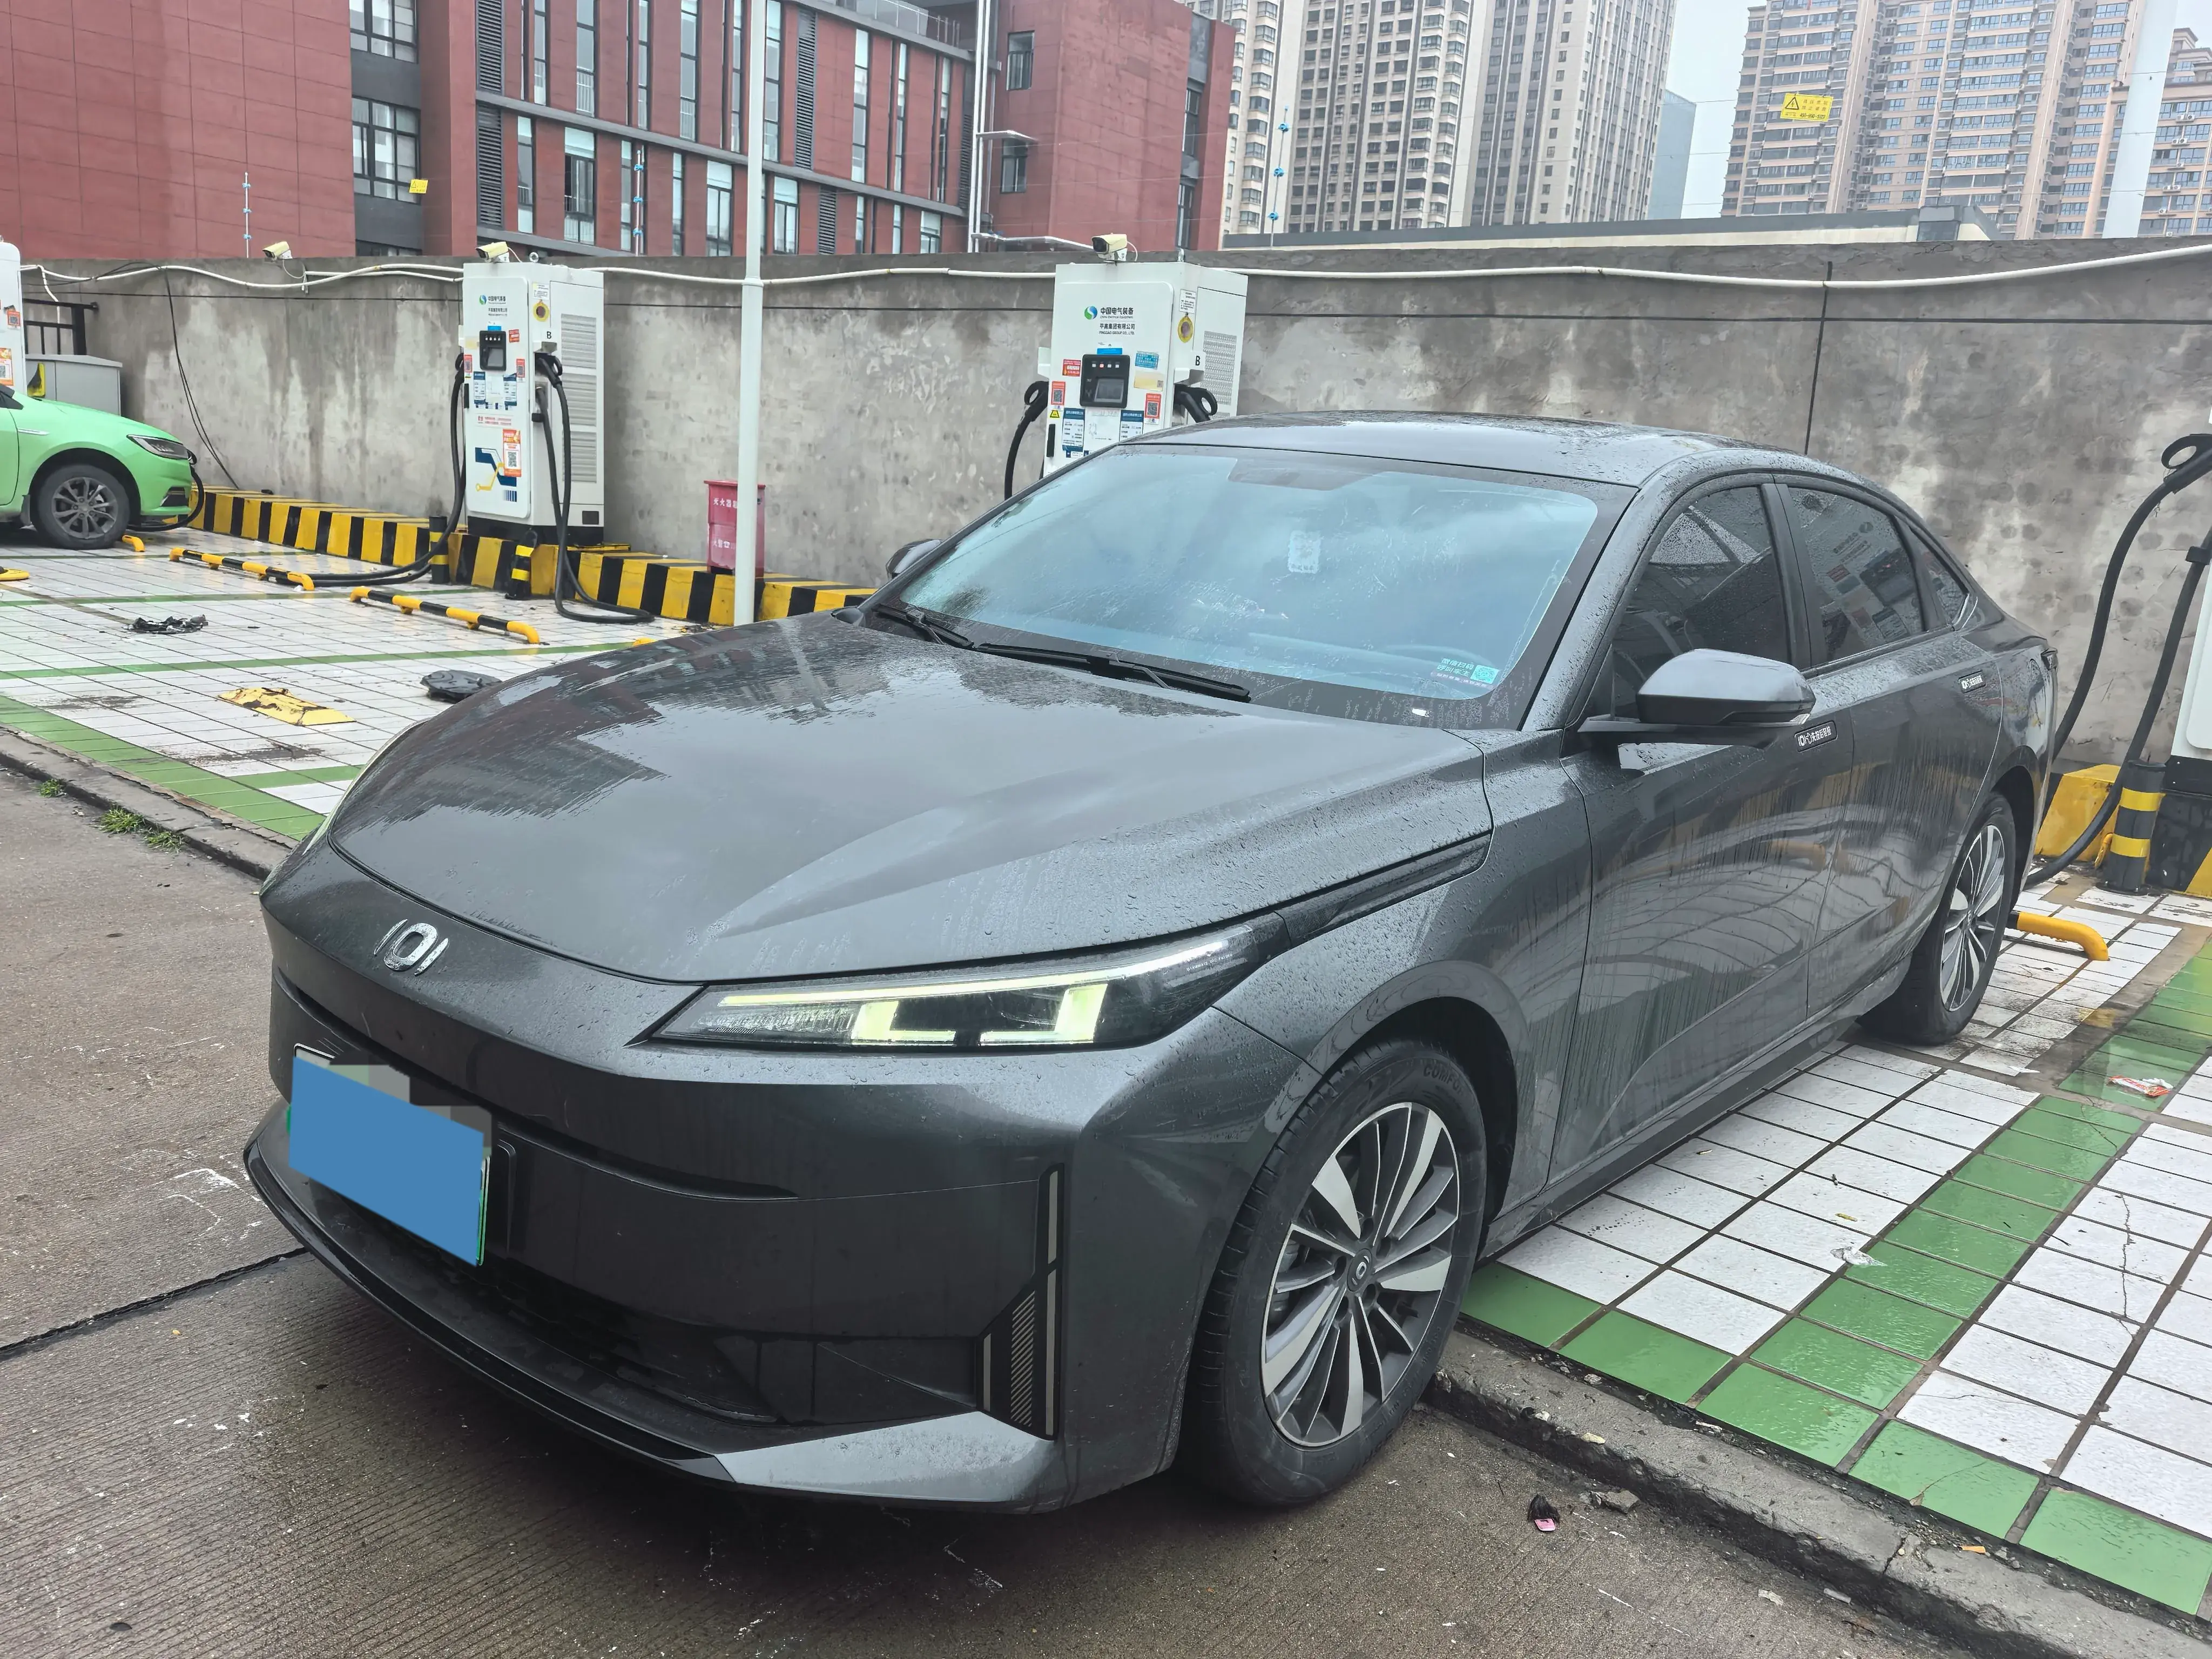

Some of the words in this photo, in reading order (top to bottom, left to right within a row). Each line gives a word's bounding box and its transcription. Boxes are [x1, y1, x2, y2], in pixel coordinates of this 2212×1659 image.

[547, 331, 552, 339] B
[1195, 355, 1201, 366] B
[1441, 658, 1474, 670] 微信扫码
[1437, 665, 1469, 677] 呼叫车主
